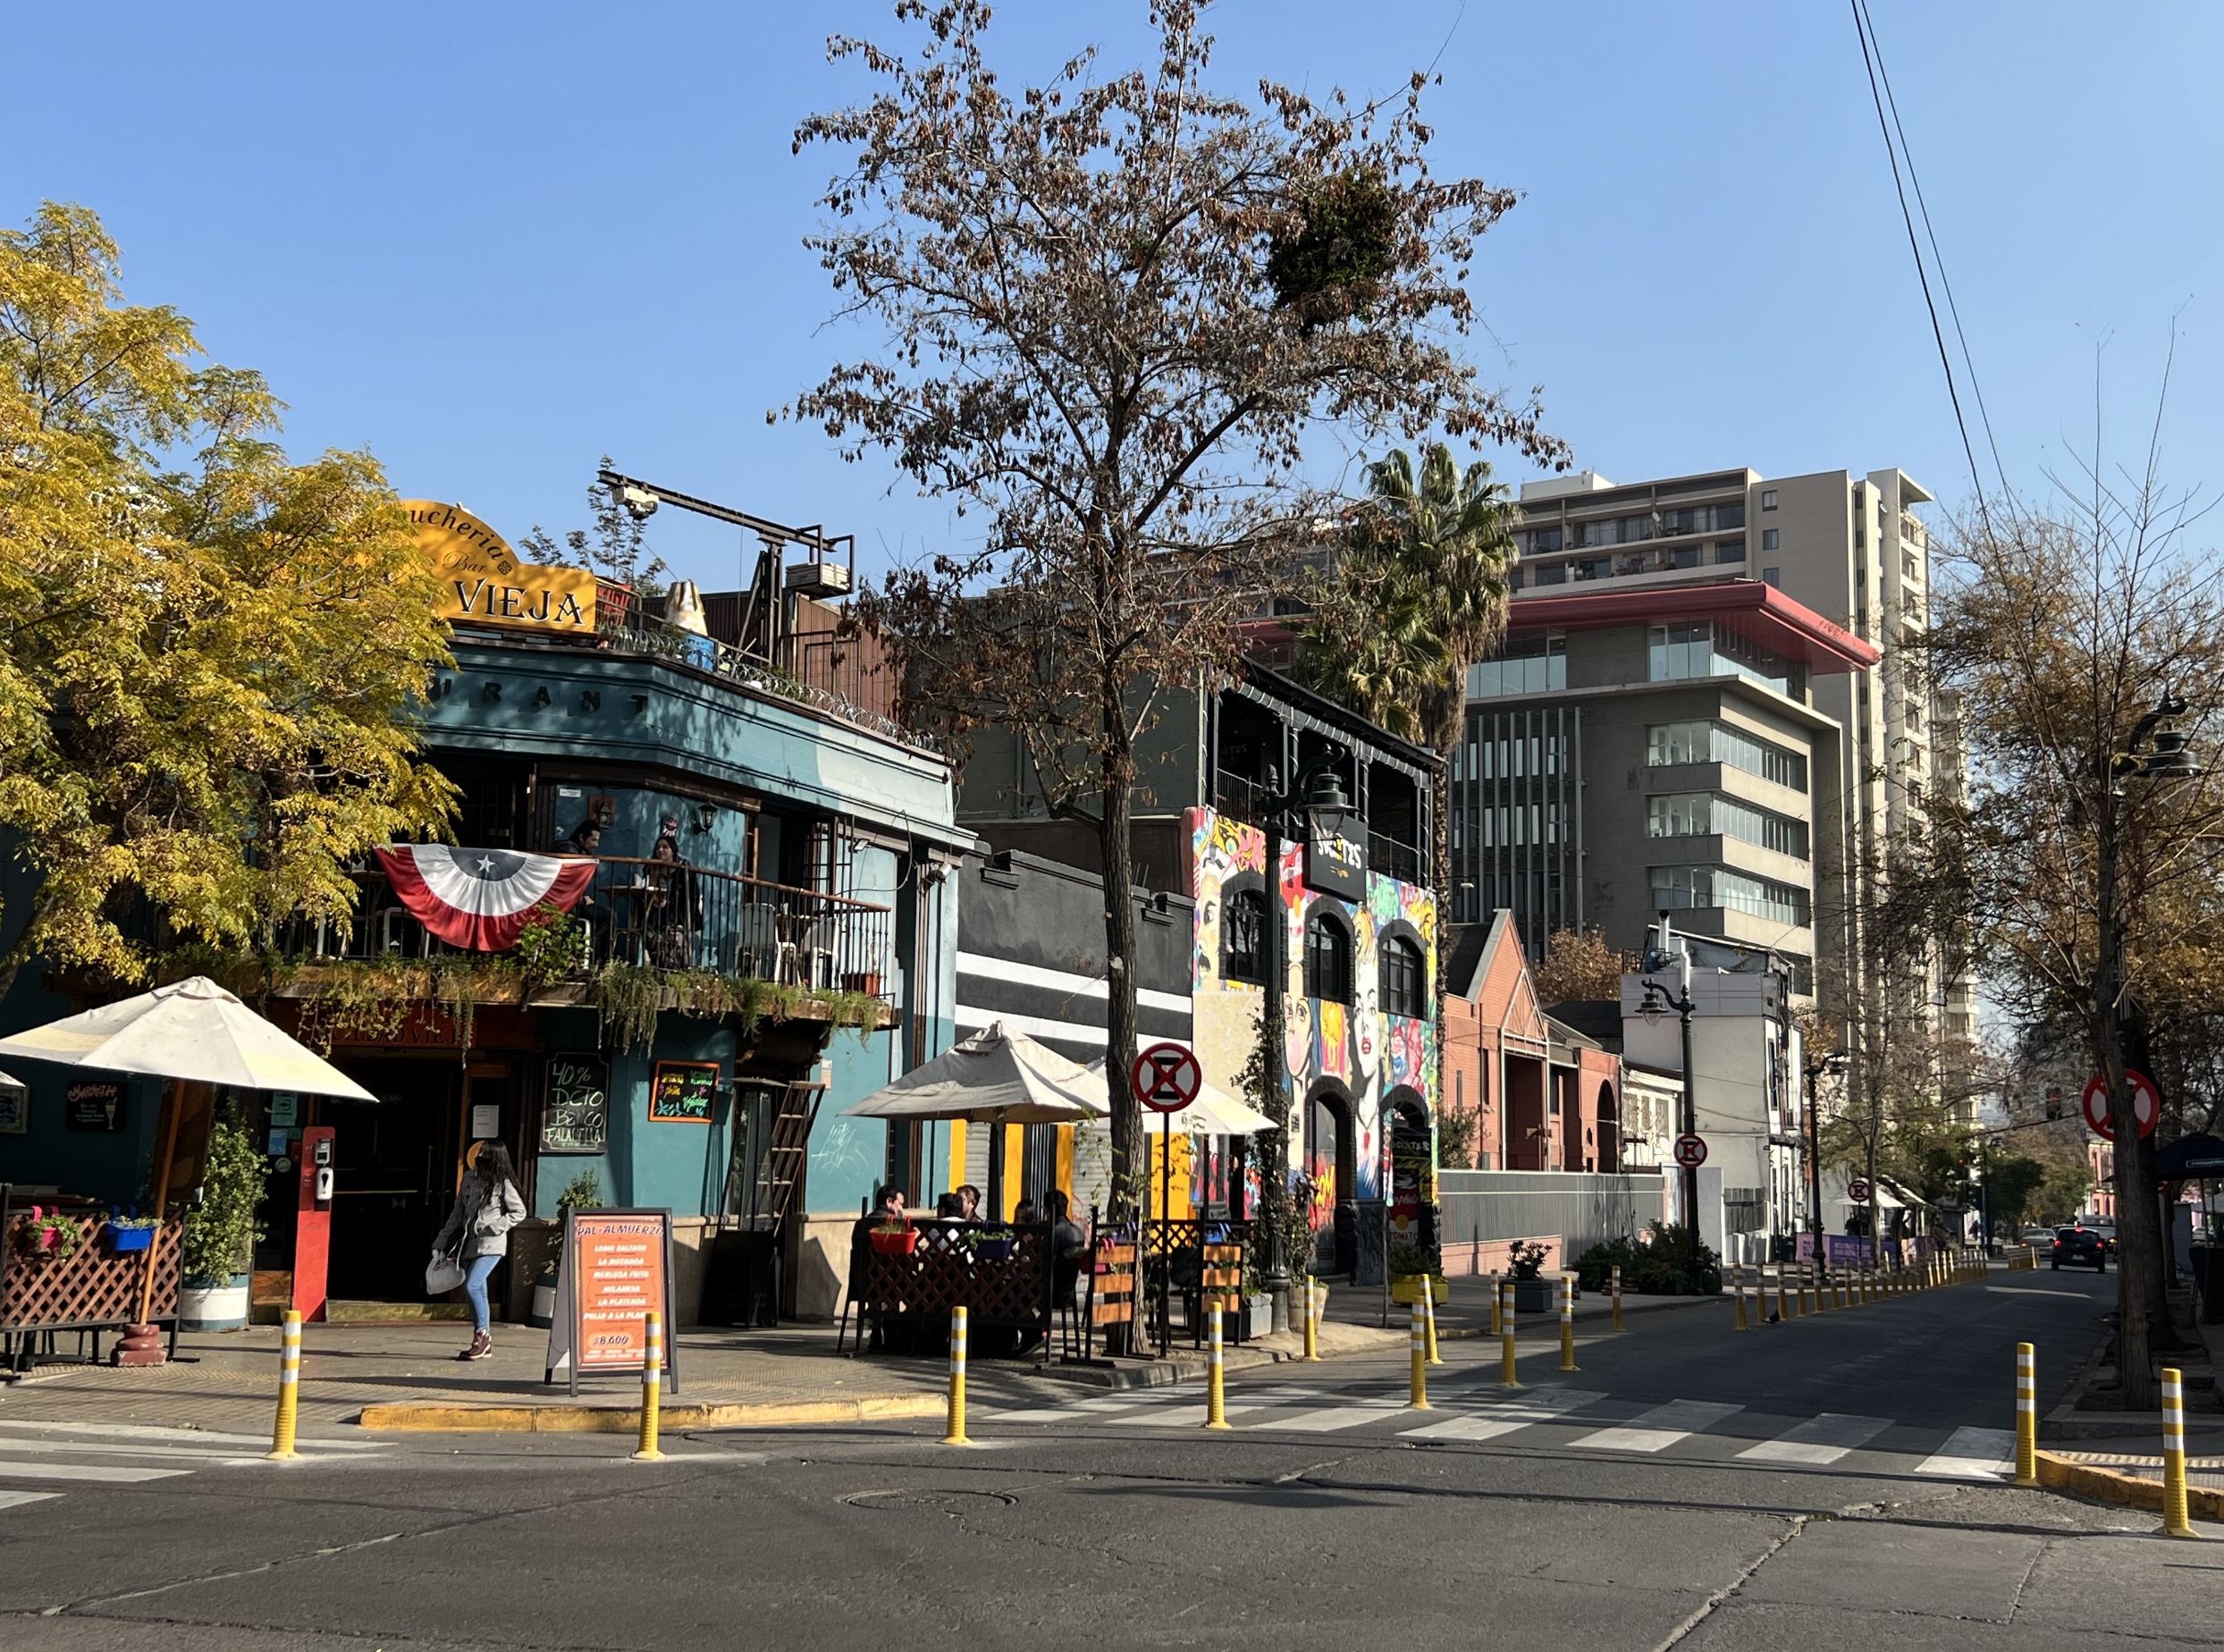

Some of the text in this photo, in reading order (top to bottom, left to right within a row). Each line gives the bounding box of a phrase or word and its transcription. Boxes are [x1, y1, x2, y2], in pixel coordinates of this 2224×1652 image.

[410, 509, 504, 560] ucheria
[442, 551, 488, 573] Bar
[453, 577, 585, 627] VIEJA
[431, 677, 649, 714] URANT
[411, 1027, 465, 1045] VIEJ
[552, 1062, 591, 1085] 40%
[552, 1085, 604, 1107] DCTO
[550, 1108, 603, 1128] BaCO
[577, 1224, 663, 1236] PAL ALMUERZO
[594, 1244, 615, 1252] LOMO
[598, 1258, 607, 1266] LA
[593, 1270, 628, 1278] MERLUZA
[583, 1312, 607, 1320] POLLO
[615, 1311, 625, 1319] LA
